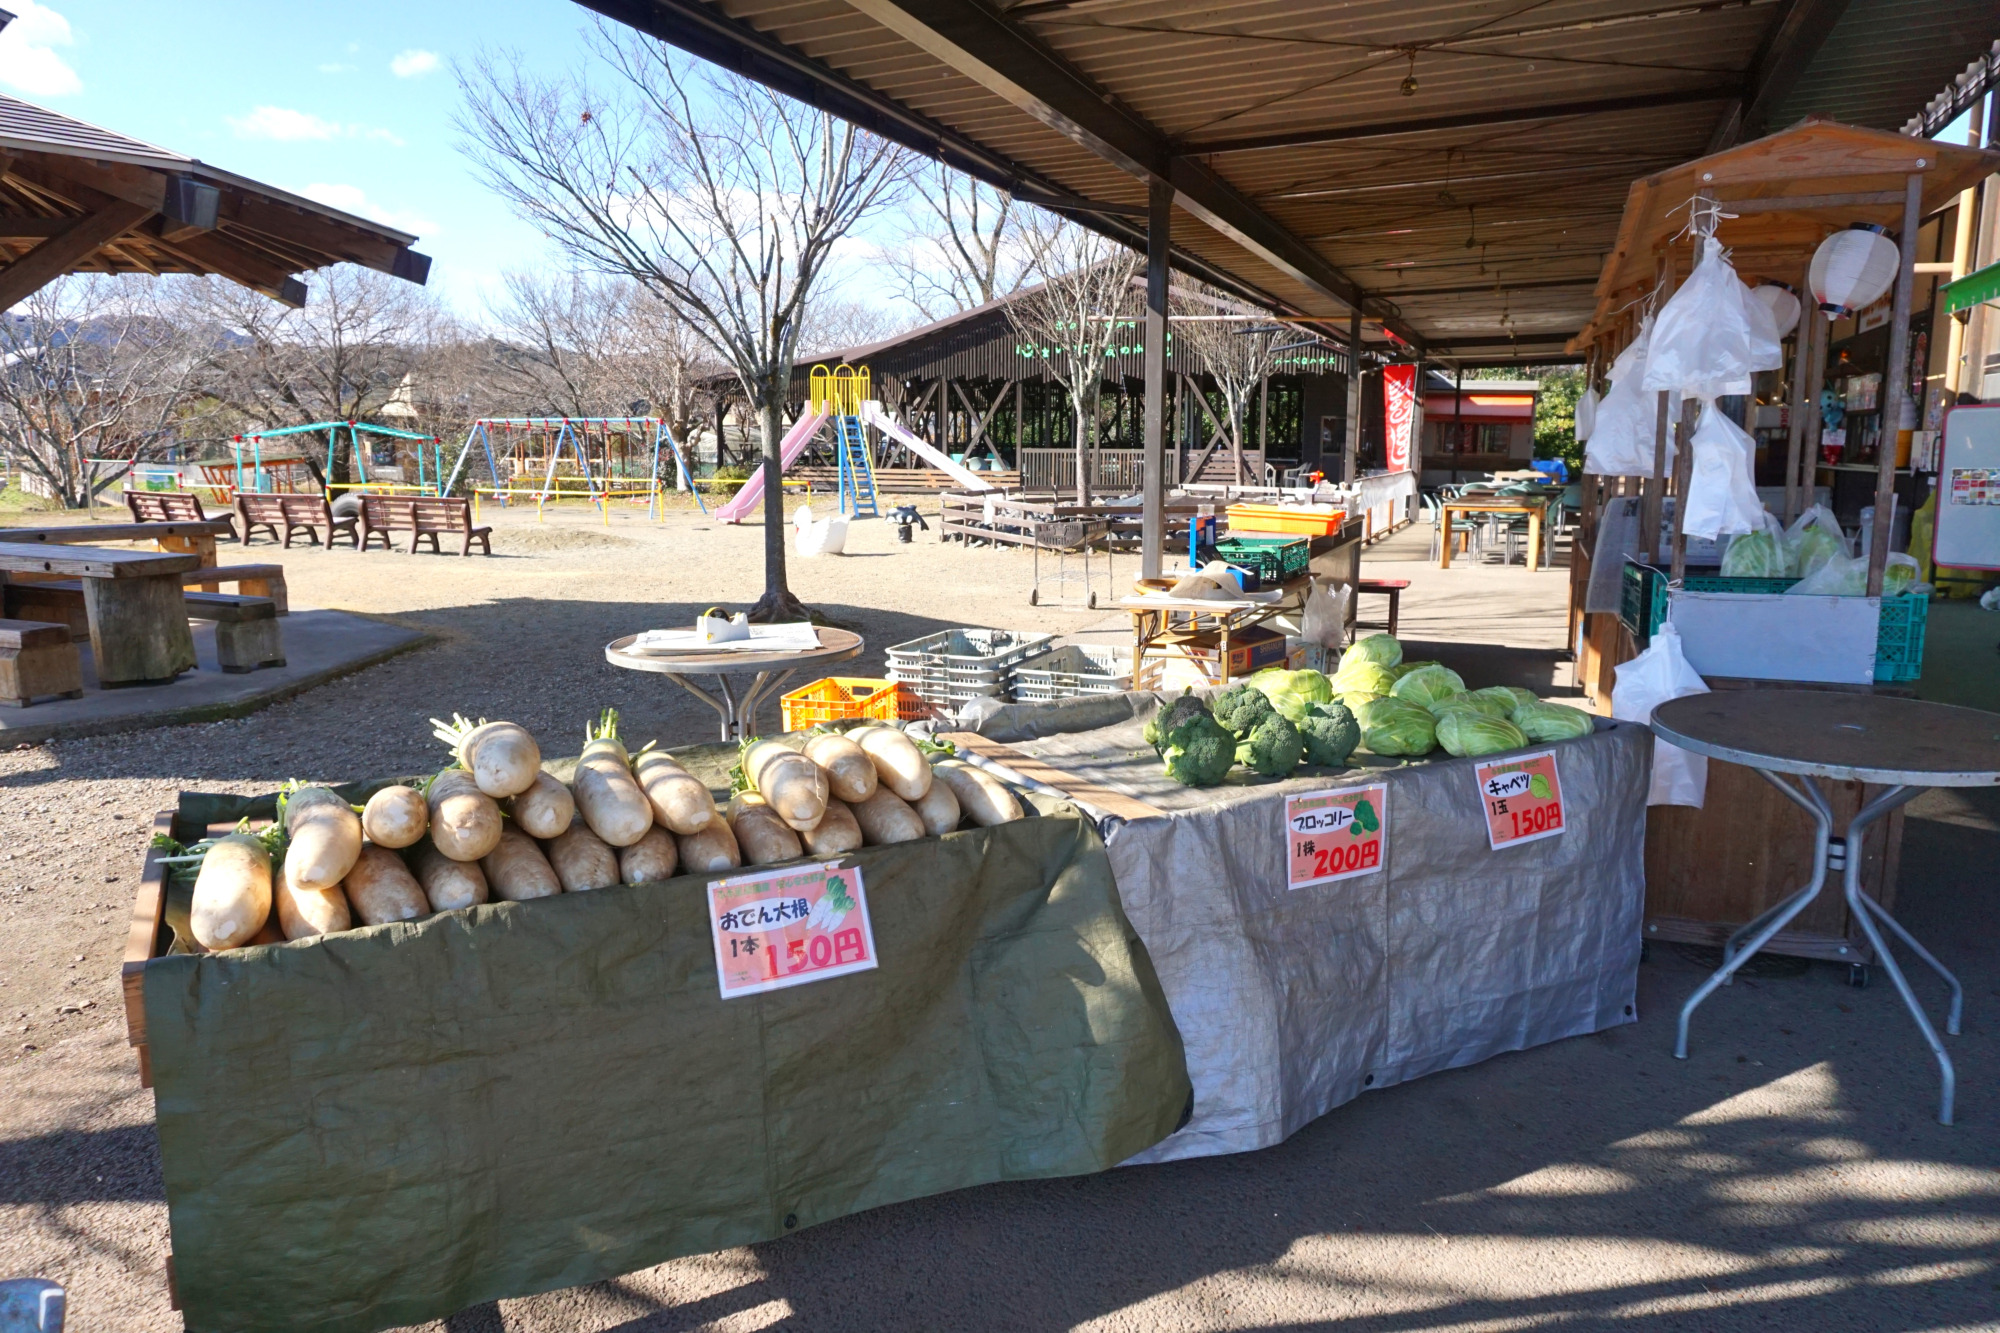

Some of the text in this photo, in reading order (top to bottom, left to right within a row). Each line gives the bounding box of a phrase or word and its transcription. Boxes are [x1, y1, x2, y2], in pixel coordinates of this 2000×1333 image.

[1489, 774, 1529, 795] キャベツ
[1491, 799, 1509, 816] 1玉
[1511, 802, 1561, 837] 150円
[1297, 840, 1315, 857] 1株
[1313, 840, 1379, 876] 200円
[720, 898, 809, 931] おでん大根
[730, 936, 760, 958] 1本
[765, 928, 866, 977] 150円
